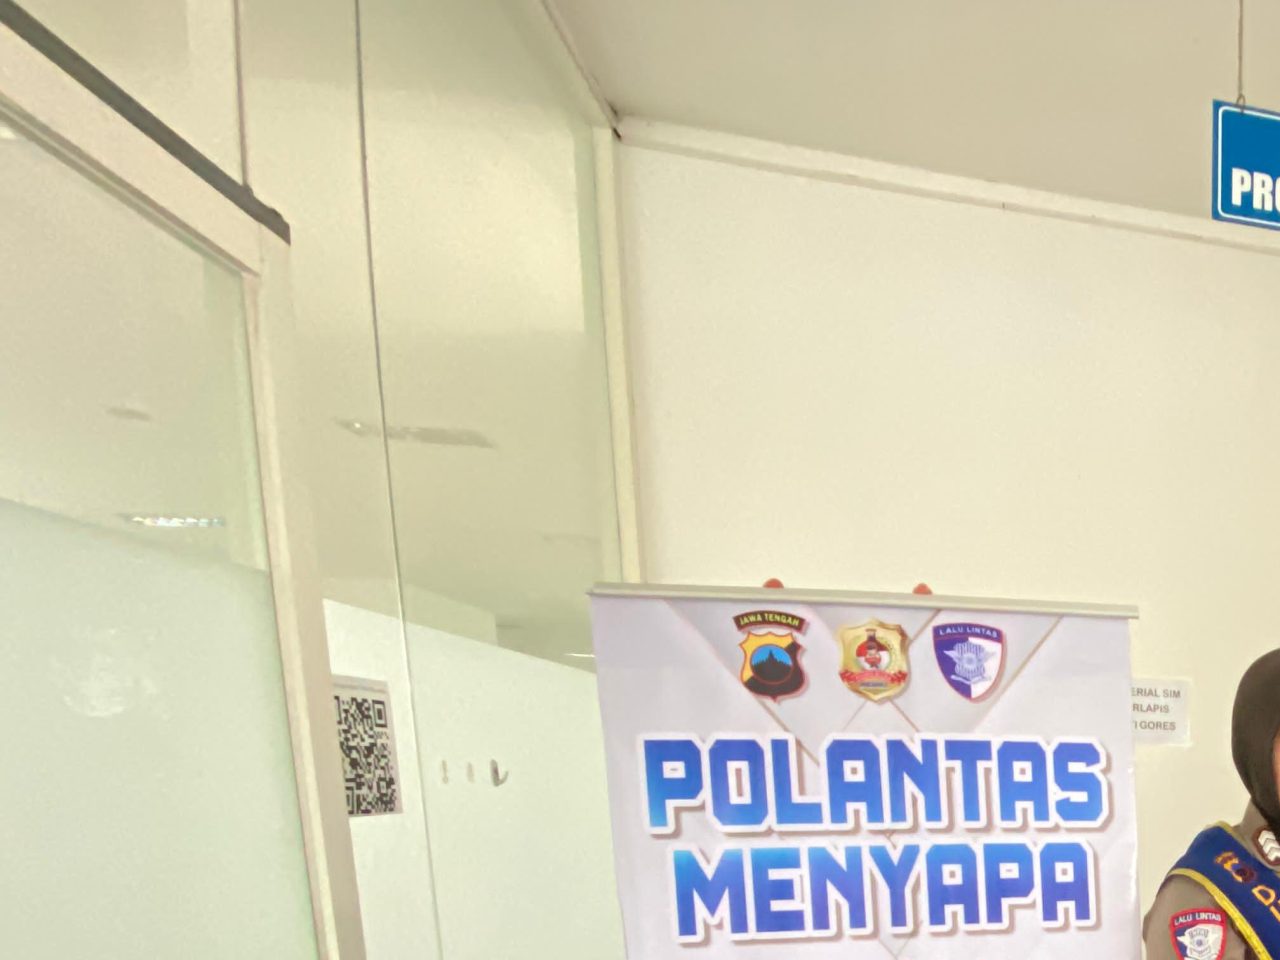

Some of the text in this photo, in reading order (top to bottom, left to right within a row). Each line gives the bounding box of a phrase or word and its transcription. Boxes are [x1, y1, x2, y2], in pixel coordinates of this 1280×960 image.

[740, 612, 799, 626] JAWA TENGAH
[939, 626, 998, 638] LALU LINTAS
[1131, 687, 1181, 699] ERIAL SIM
[1132, 703, 1170, 714] RLAPIS
[1139, 720, 1176, 731] GORES
[642, 737, 1104, 829] POLANTAS
[672, 842, 1093, 938] MENYAPA
[1174, 912, 1222, 926] LALU LINTAS
